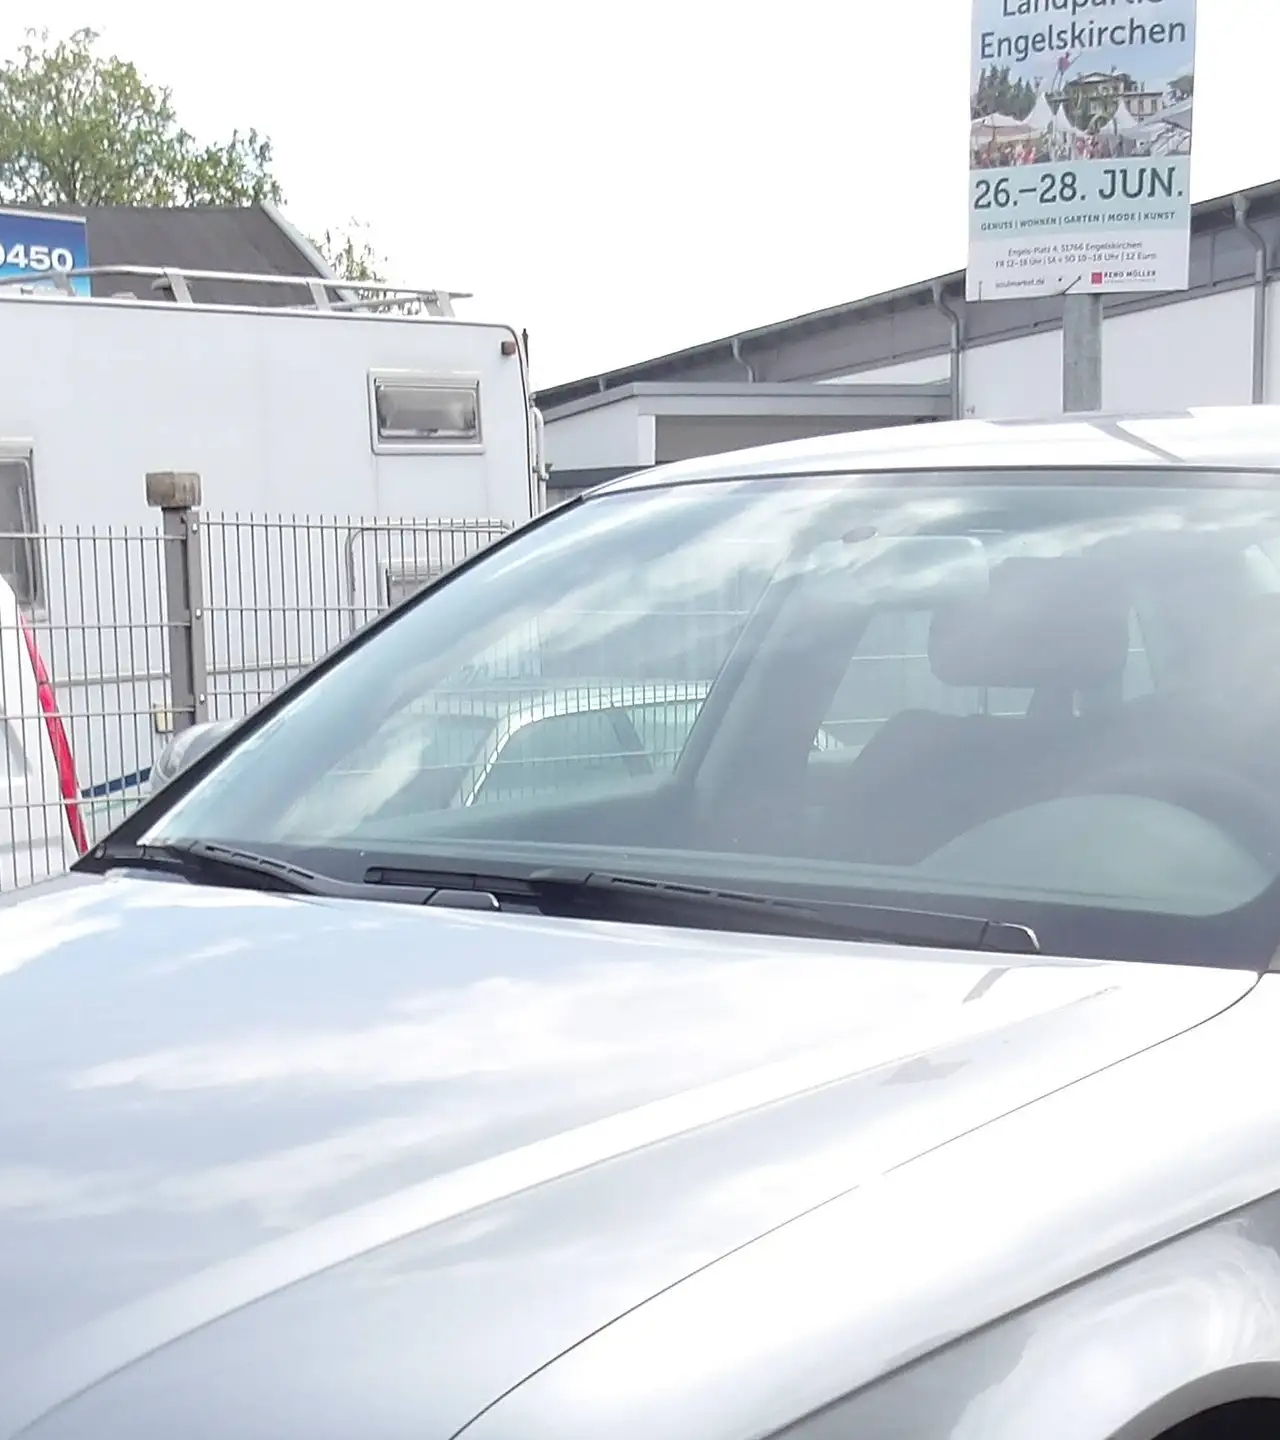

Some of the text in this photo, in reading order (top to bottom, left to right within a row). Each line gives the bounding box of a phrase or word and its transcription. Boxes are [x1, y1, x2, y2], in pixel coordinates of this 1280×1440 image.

[980, 17, 1186, 62] Engelskirchen
[1098, 167, 1184, 199] JUN.
[1064, 214, 1100, 224] GARTEN
[1107, 213, 1136, 222] MODE
[1143, 211, 1176, 221] KUNST
